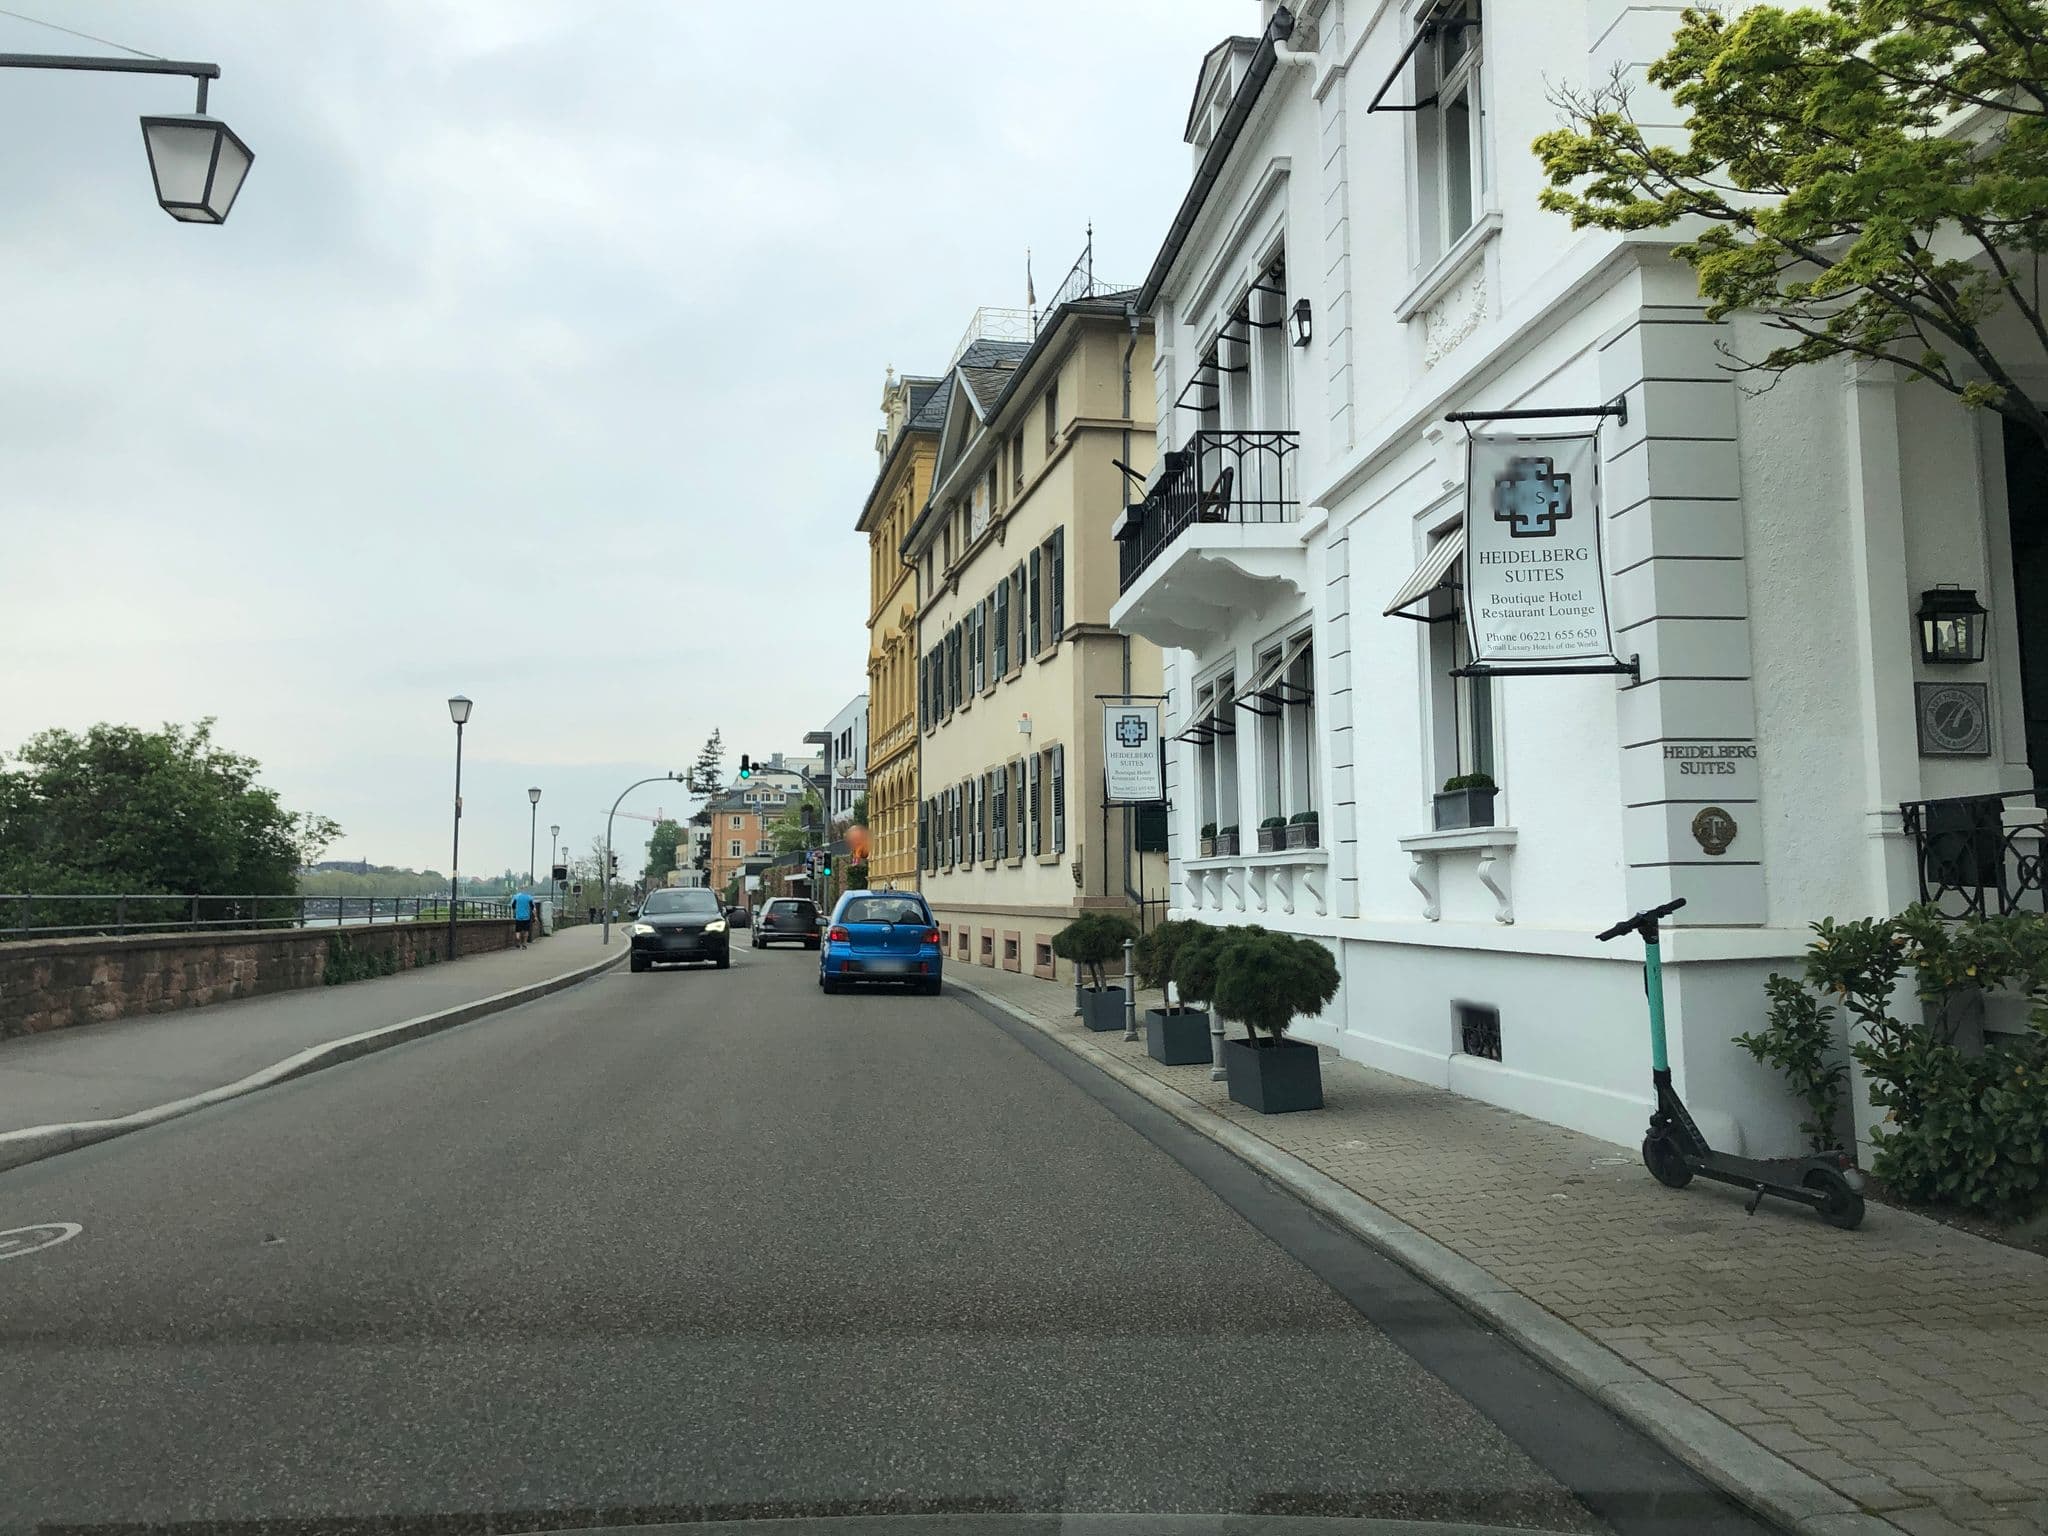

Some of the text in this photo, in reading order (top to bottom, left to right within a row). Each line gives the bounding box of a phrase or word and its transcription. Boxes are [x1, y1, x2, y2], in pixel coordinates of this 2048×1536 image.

[1480, 547, 1588, 565] HEIDELBERG
[1505, 568, 1564, 583] SUITES
[1491, 590, 1582, 606] Boutique Hotel
[1482, 605, 1595, 619] Restaurant Lounge
[1486, 628, 1597, 642] Phone 06221 655 650
[1663, 745, 1758, 759] HEIDELBERG
[1680, 761, 1736, 775] SUITES
